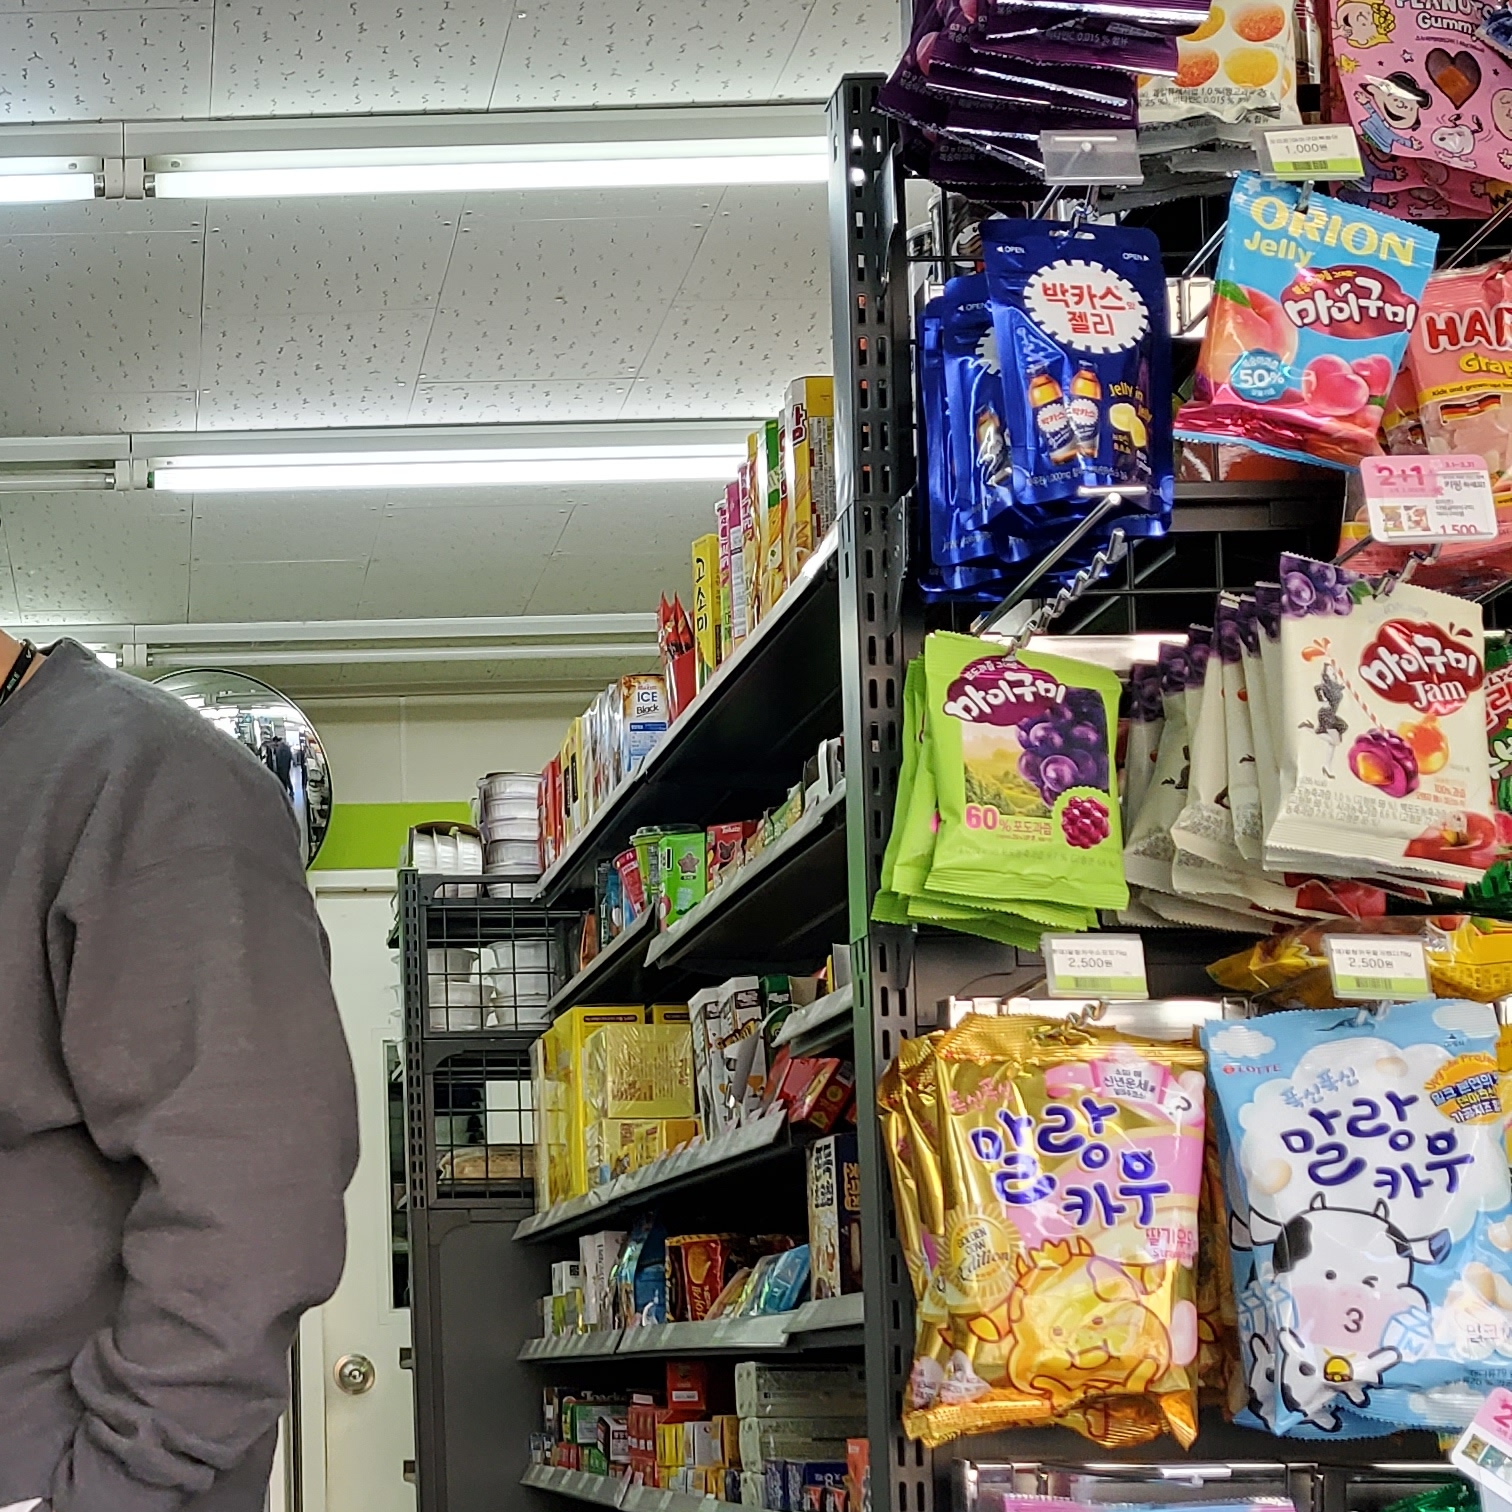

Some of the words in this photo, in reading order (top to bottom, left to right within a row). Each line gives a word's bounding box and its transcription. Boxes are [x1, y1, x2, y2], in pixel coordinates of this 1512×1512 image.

[1417, 12, 1482, 42] Gummy
[1284, 143, 1329, 156] 1,000원
[1249, 195, 1416, 267] ORION
[1004, 244, 1025, 254] OPEN
[1122, 250, 1144, 262] OPEN
[1243, 231, 1313, 269] Jelly
[1041, 281, 1126, 311] 박카스
[1284, 276, 1418, 330] 마이구미
[1067, 311, 1115, 337] 젤리
[1238, 369, 1285, 387] 50%
[1109, 383, 1134, 398] Jelly
[1039, 411, 1068, 427] 박카스
[1071, 405, 1097, 420] 박카스
[1377, 464, 1426, 486] 2+1
[1361, 633, 1478, 690] 마이구미
[637, 690, 659, 703] ICE
[944, 670, 1067, 721] 마이구미
[1412, 677, 1468, 710] Jam
[636, 703, 661, 716] Black
[1068, 957, 1113, 970] 2,500원
[1348, 957, 1394, 969] 2,500원
[1237, 1062, 1281, 1075] LOTTE
[969, 1096, 1119, 1206] 말랑
[1281, 1091, 1419, 1187] 말랑
[1374, 1127, 1474, 1198] 카우
[1062, 1149, 1172, 1228] 카우
